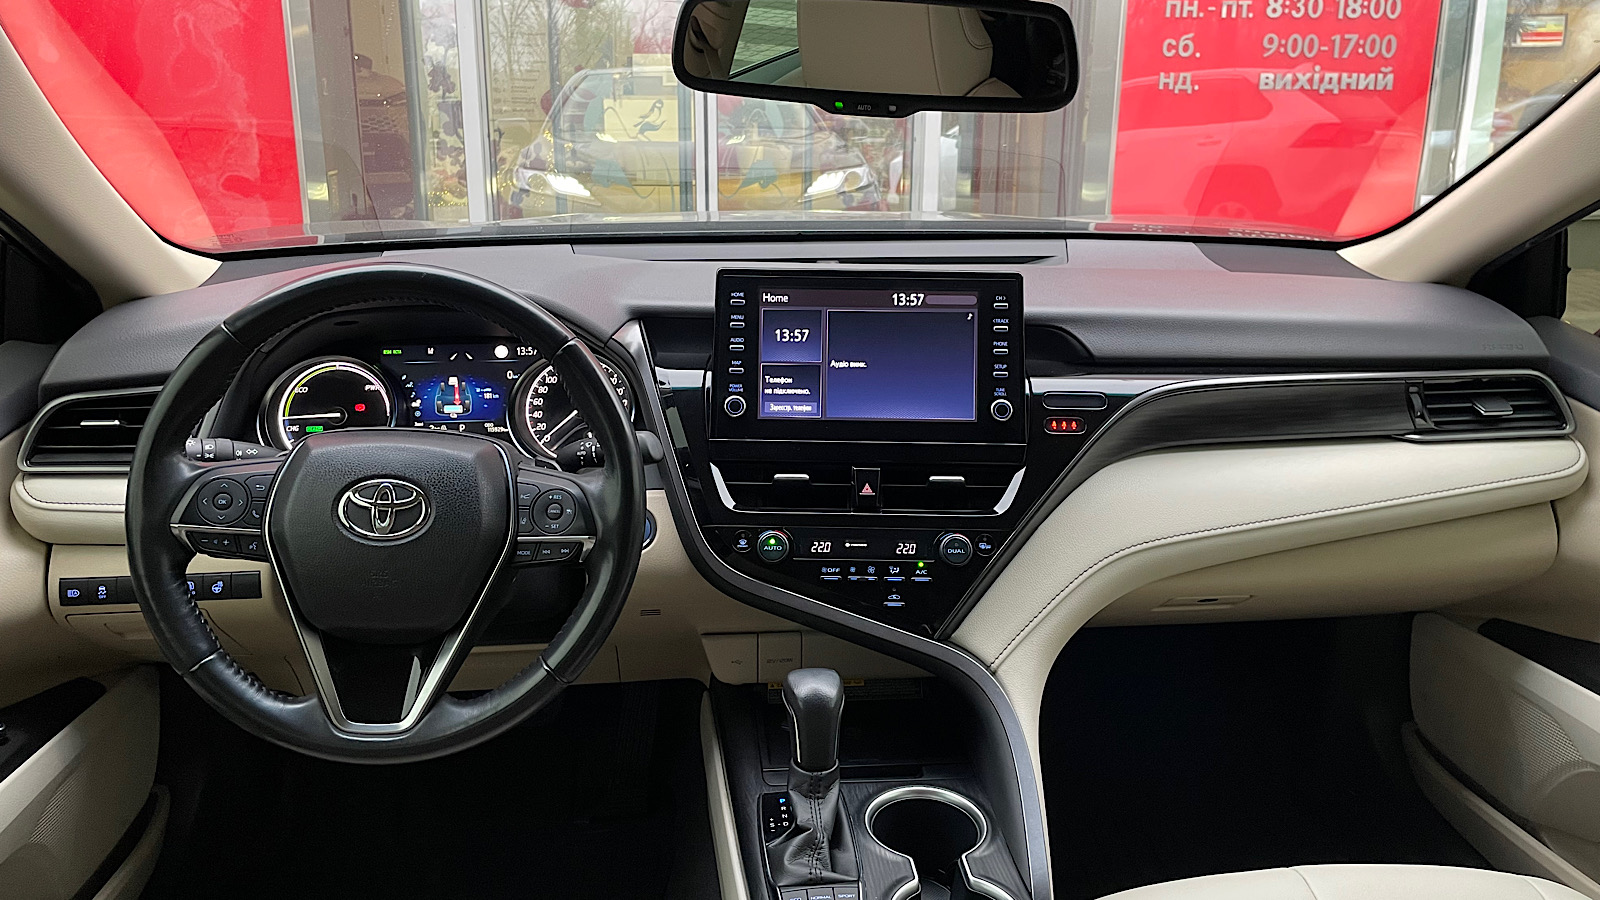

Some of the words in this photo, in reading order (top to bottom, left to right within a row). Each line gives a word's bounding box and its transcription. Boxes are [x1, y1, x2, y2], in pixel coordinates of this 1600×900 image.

[1162, 33, 1200, 58] сб.
[1262, 33, 1397, 59] 9:00-17:00
[1158, 71, 1199, 94] нд.
[1258, 65, 1394, 94] вихідний
[762, 292, 789, 303] Home
[892, 293, 925, 307] 13:57
[774, 328, 810, 342] 13:57
[545, 375, 558, 384] 100
[537, 386, 548, 394] 80
[532, 398, 543, 406] 60
[532, 410, 543, 418] 40
[285, 424, 299, 432] CHG
[536, 422, 547, 431] 20
